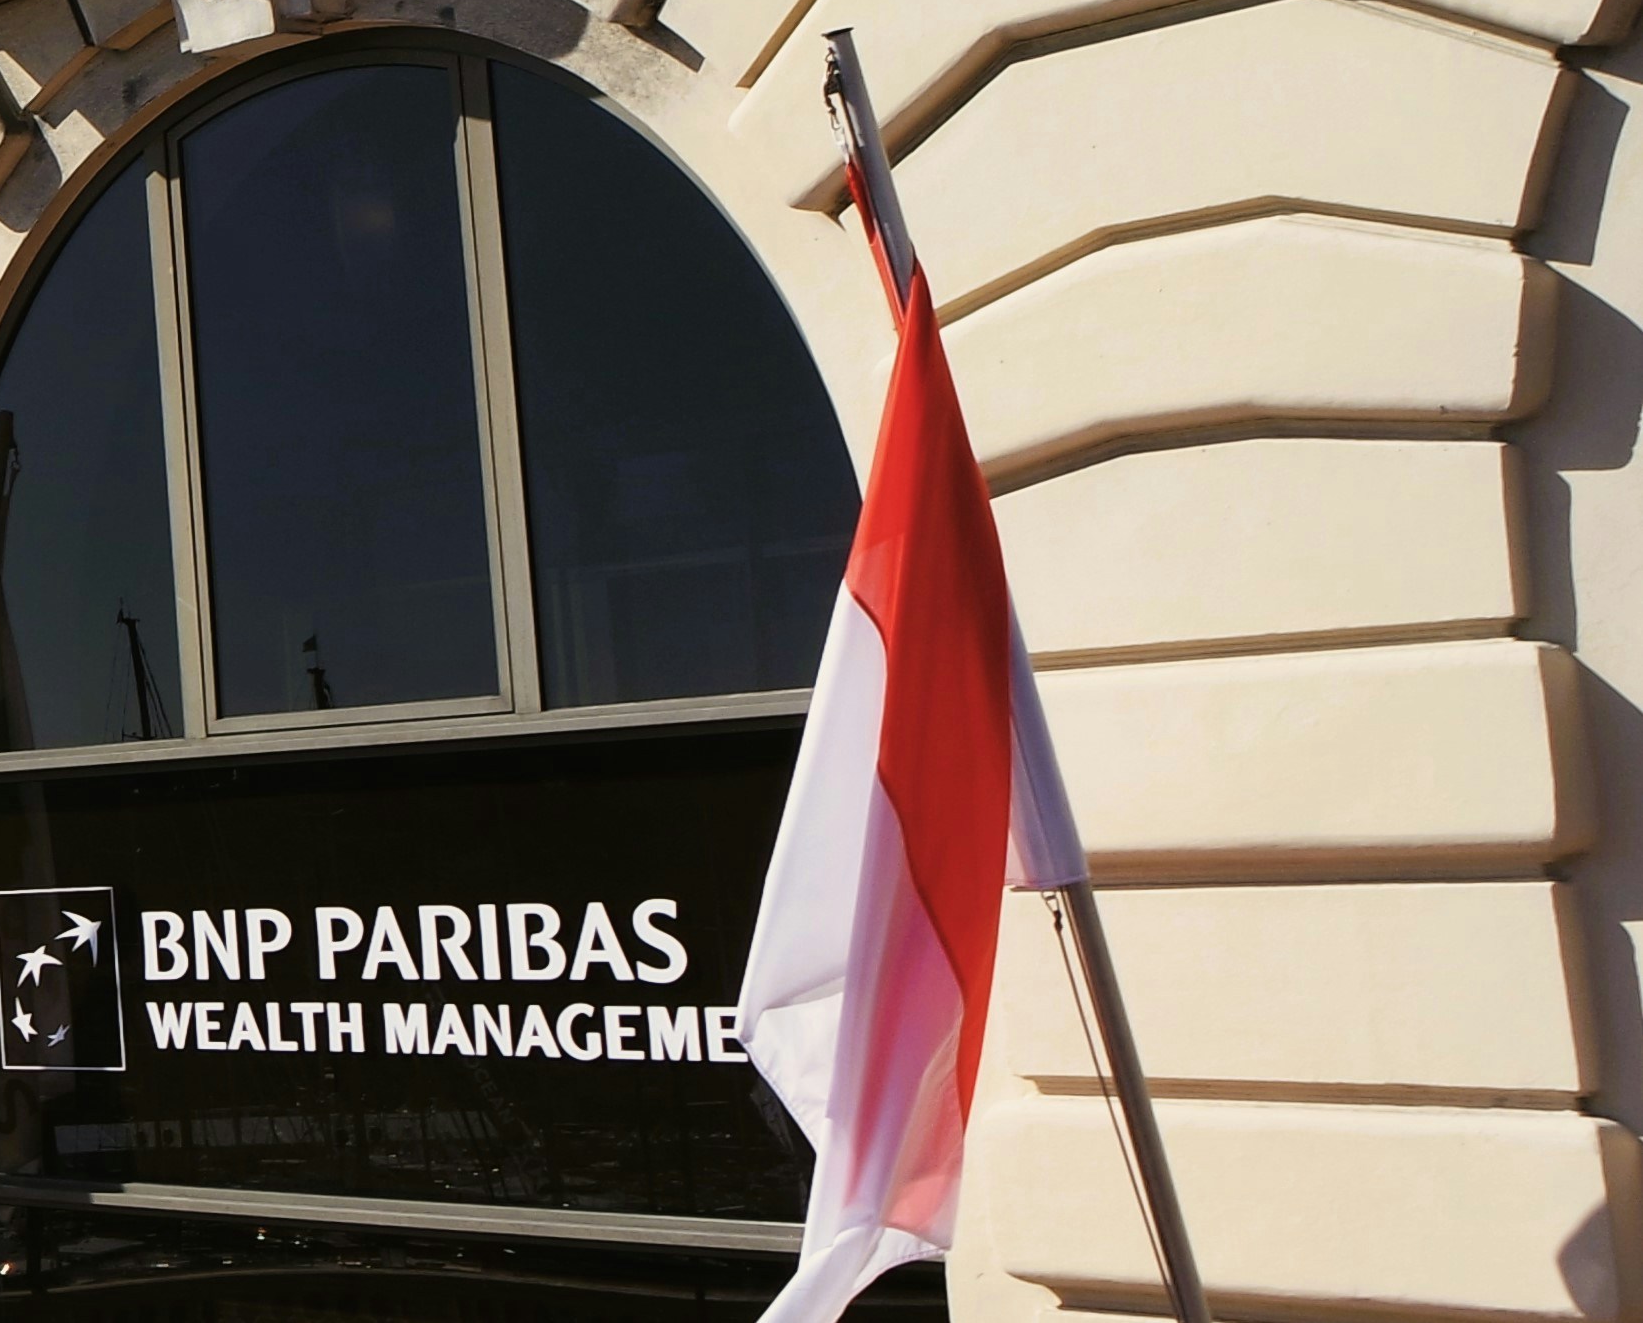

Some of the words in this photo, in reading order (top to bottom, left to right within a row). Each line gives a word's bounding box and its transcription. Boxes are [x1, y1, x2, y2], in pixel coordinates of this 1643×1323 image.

[142, 908, 292, 981] BNP
[316, 899, 688, 983] PARIBAS
[146, 1001, 366, 1053] WEALTH
[382, 1002, 747, 1062] MANAGEME
